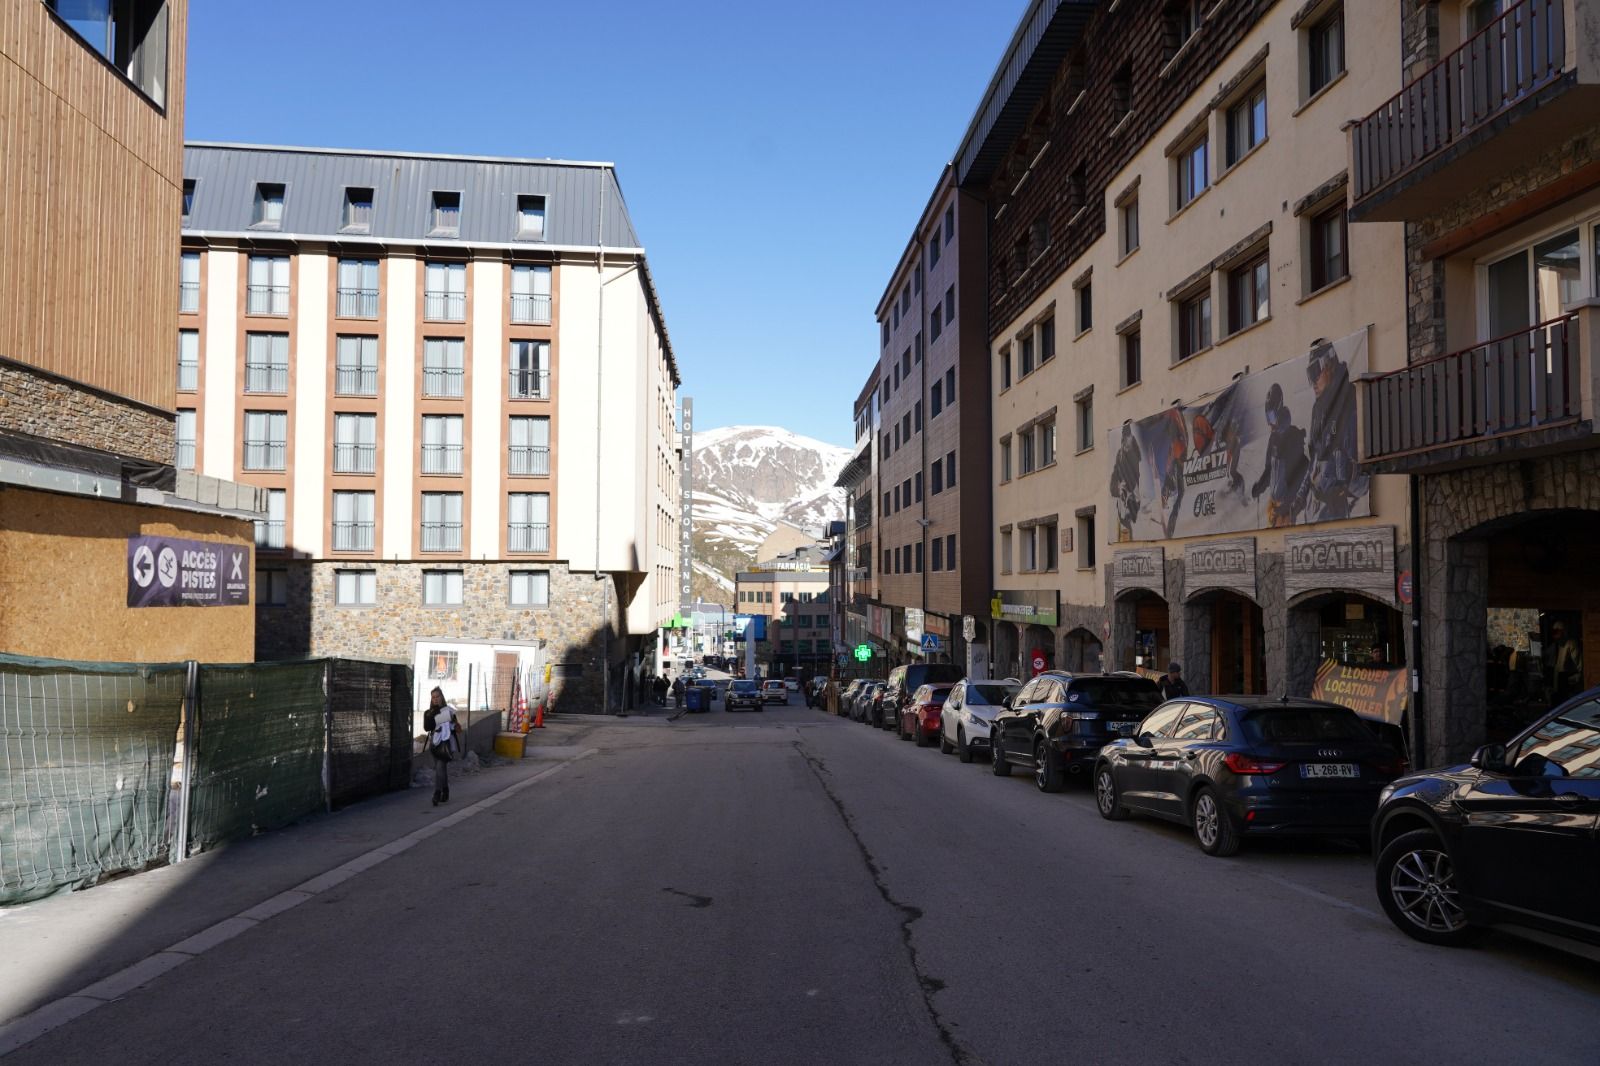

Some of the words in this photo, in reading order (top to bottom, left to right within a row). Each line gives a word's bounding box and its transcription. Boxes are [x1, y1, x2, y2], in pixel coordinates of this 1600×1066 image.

[1192, 549, 1246, 574] LLOGUER
[1292, 541, 1383, 573] LOCATION
[1122, 557, 1154, 577] RENTAL
[181, 571, 216, 589] PISTES
[1341, 665, 1389, 681] LLOGUER
[1325, 679, 1377, 697] LOCATION
